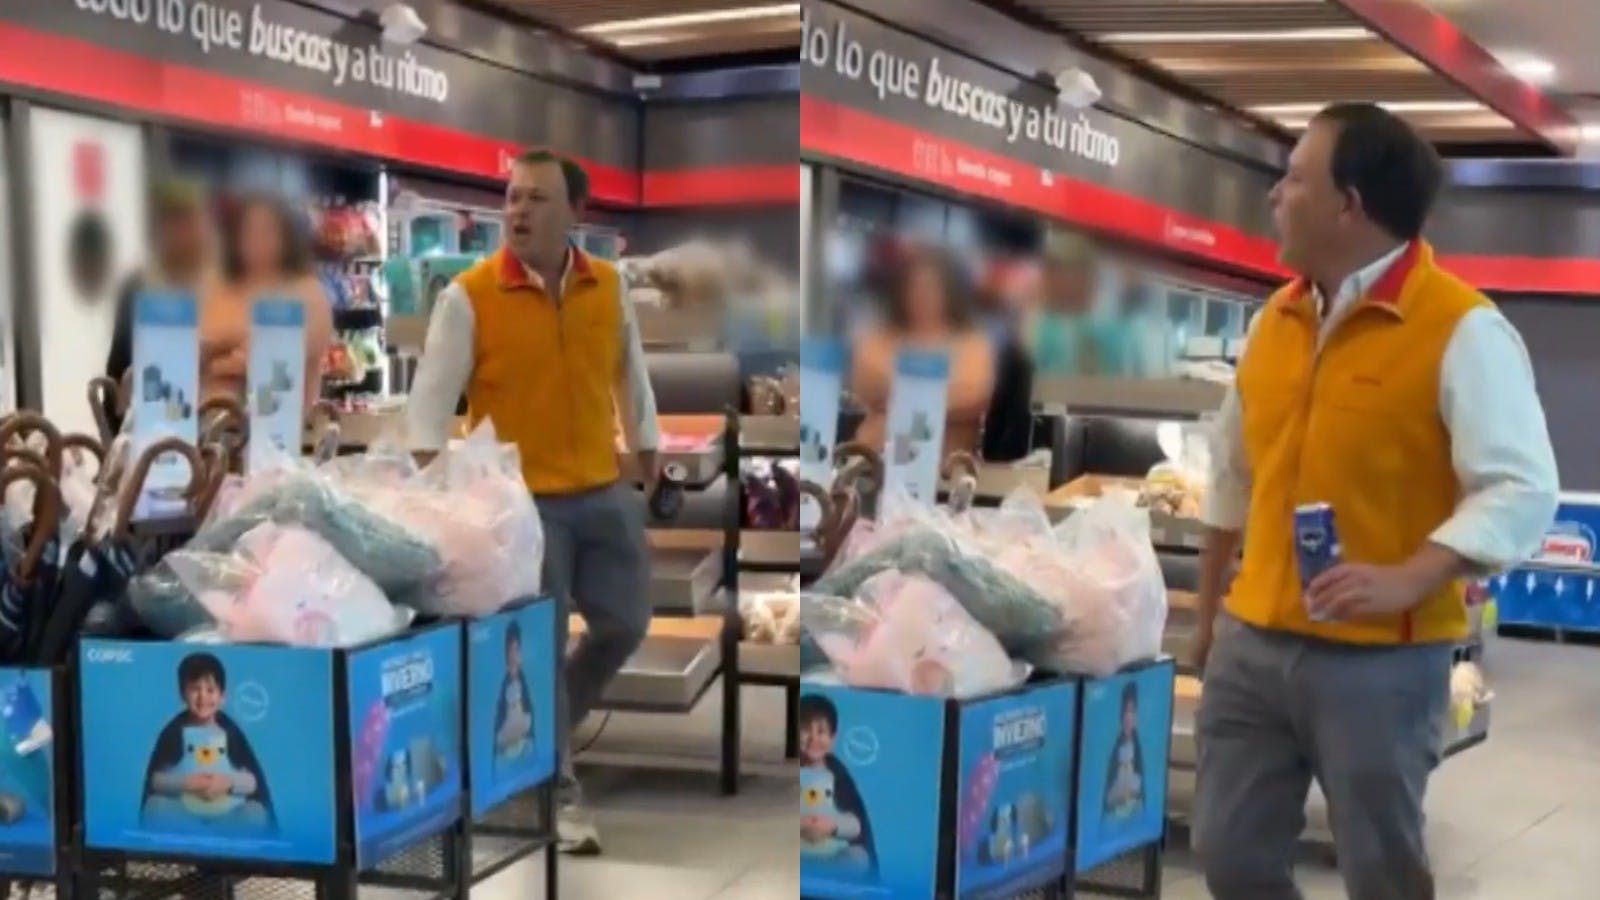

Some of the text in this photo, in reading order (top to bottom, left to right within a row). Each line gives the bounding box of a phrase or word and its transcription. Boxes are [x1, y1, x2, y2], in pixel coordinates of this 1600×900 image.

[156, 0, 185, 33] lo
[190, 3, 242, 53] que
[249, 3, 332, 72] buscas
[333, 43, 349, 86] y
[352, 47, 365, 81] a
[369, 44, 393, 88] tu
[397, 51, 448, 102] ritmo
[835, 20, 864, 78] lo
[869, 49, 919, 100] que
[924, 57, 1007, 128] buscas
[1007, 100, 1024, 143] y
[1026, 107, 1039, 139] a
[1043, 106, 1066, 149] tu
[1070, 112, 1119, 166] ritmo
